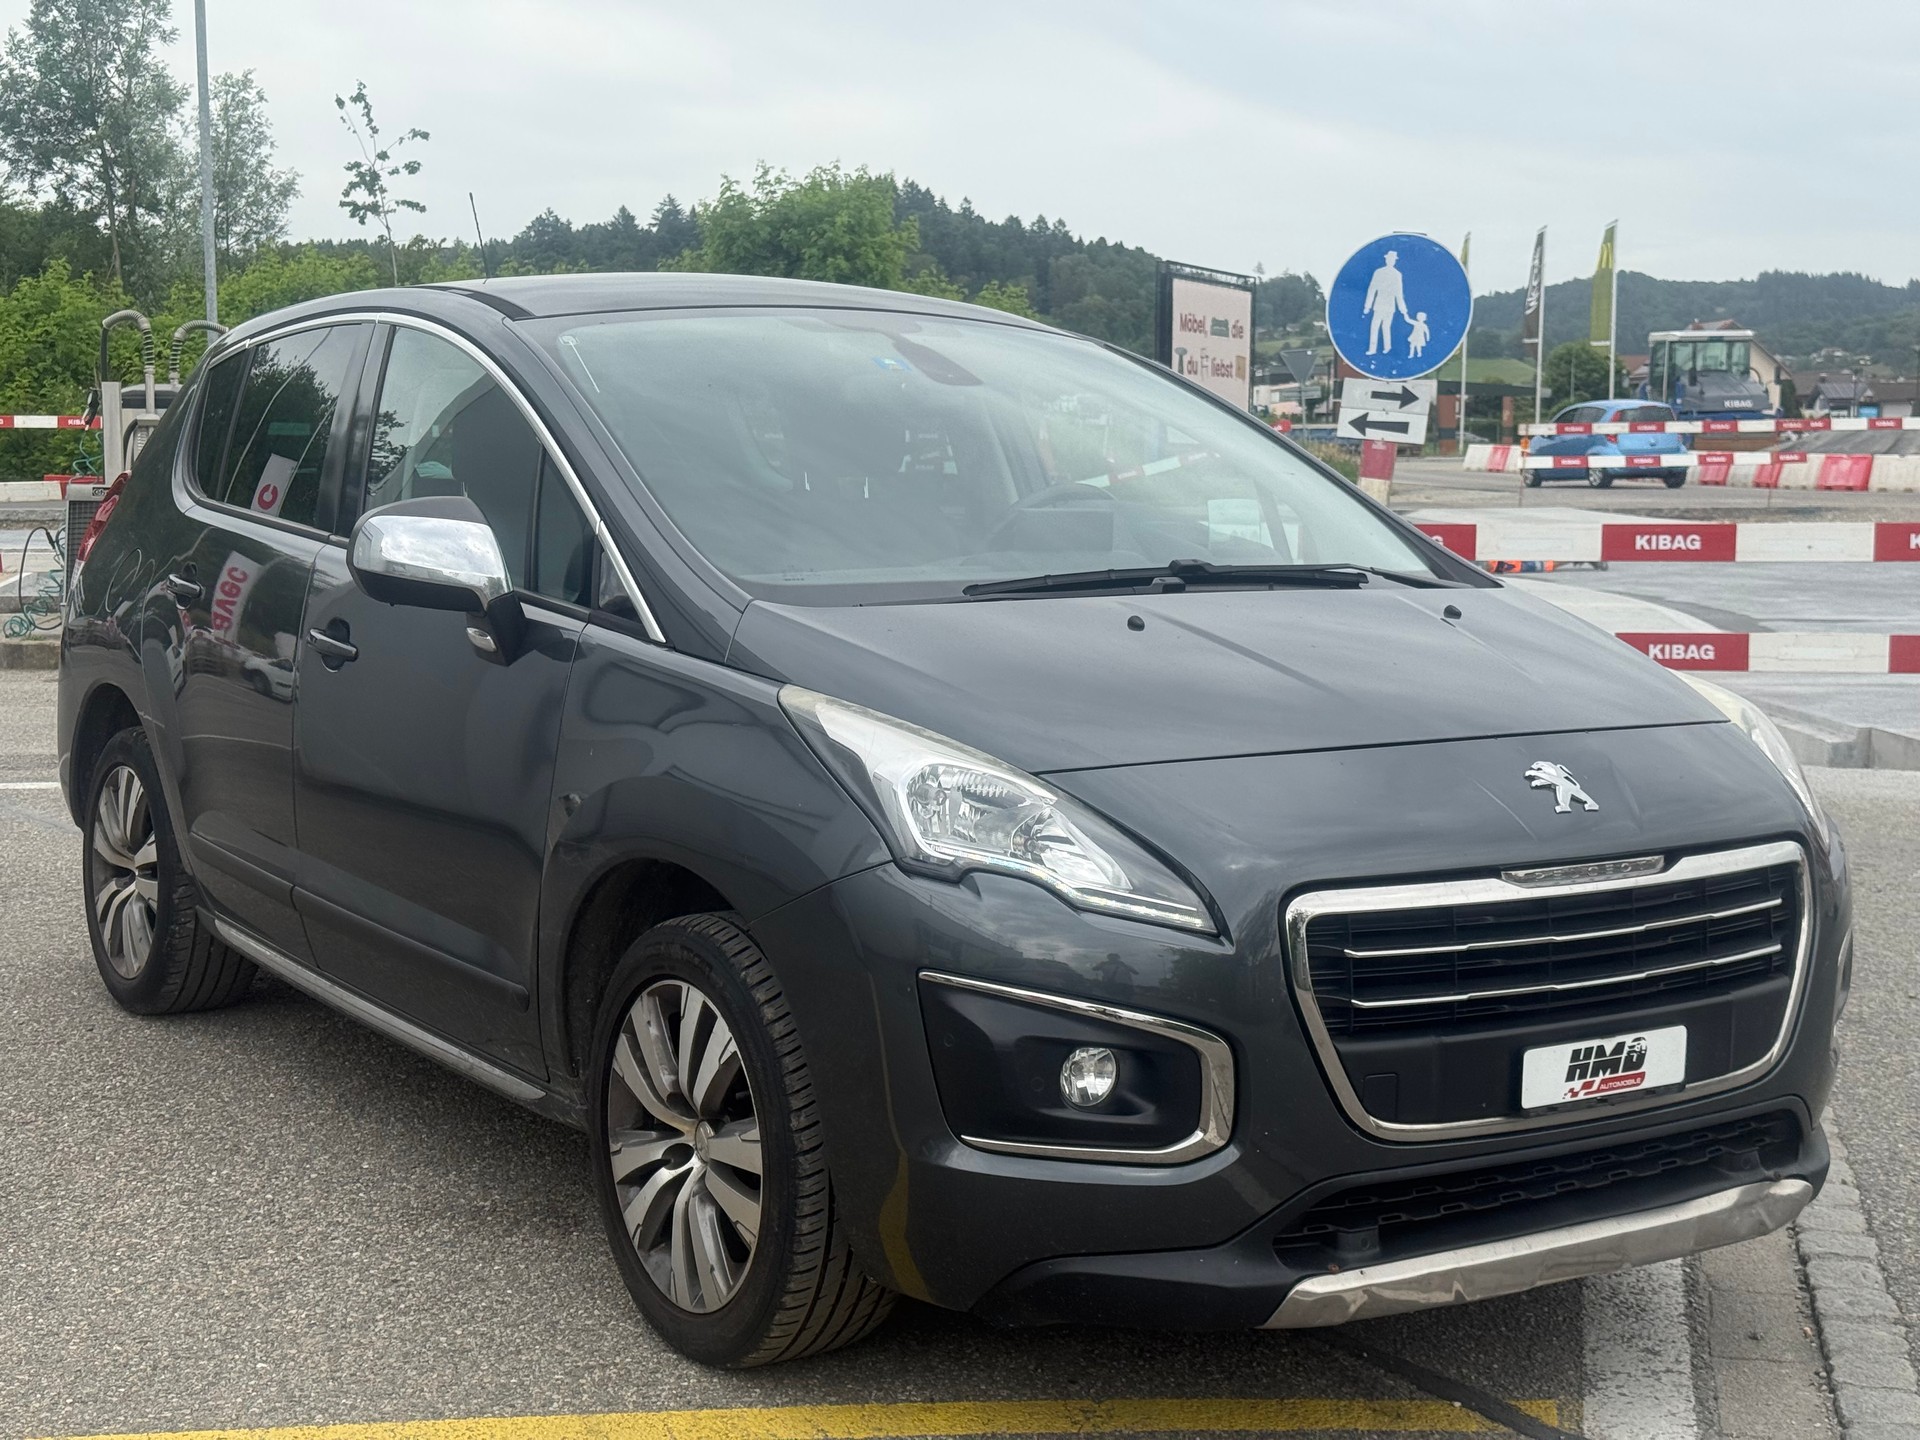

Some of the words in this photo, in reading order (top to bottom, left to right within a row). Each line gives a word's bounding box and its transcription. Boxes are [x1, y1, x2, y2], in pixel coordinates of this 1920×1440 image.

[1180, 313, 1208, 338] Möbel,
[1231, 320, 1244, 339] die
[1187, 356, 1198, 375] du
[1211, 357, 1234, 379] liebst
[1723, 399, 1753, 408] KIBAG
[1635, 534, 1702, 550] KIBAG
[1648, 644, 1715, 661] KIBAG
[1599, 1077, 1642, 1090] AUTOMOBILE
